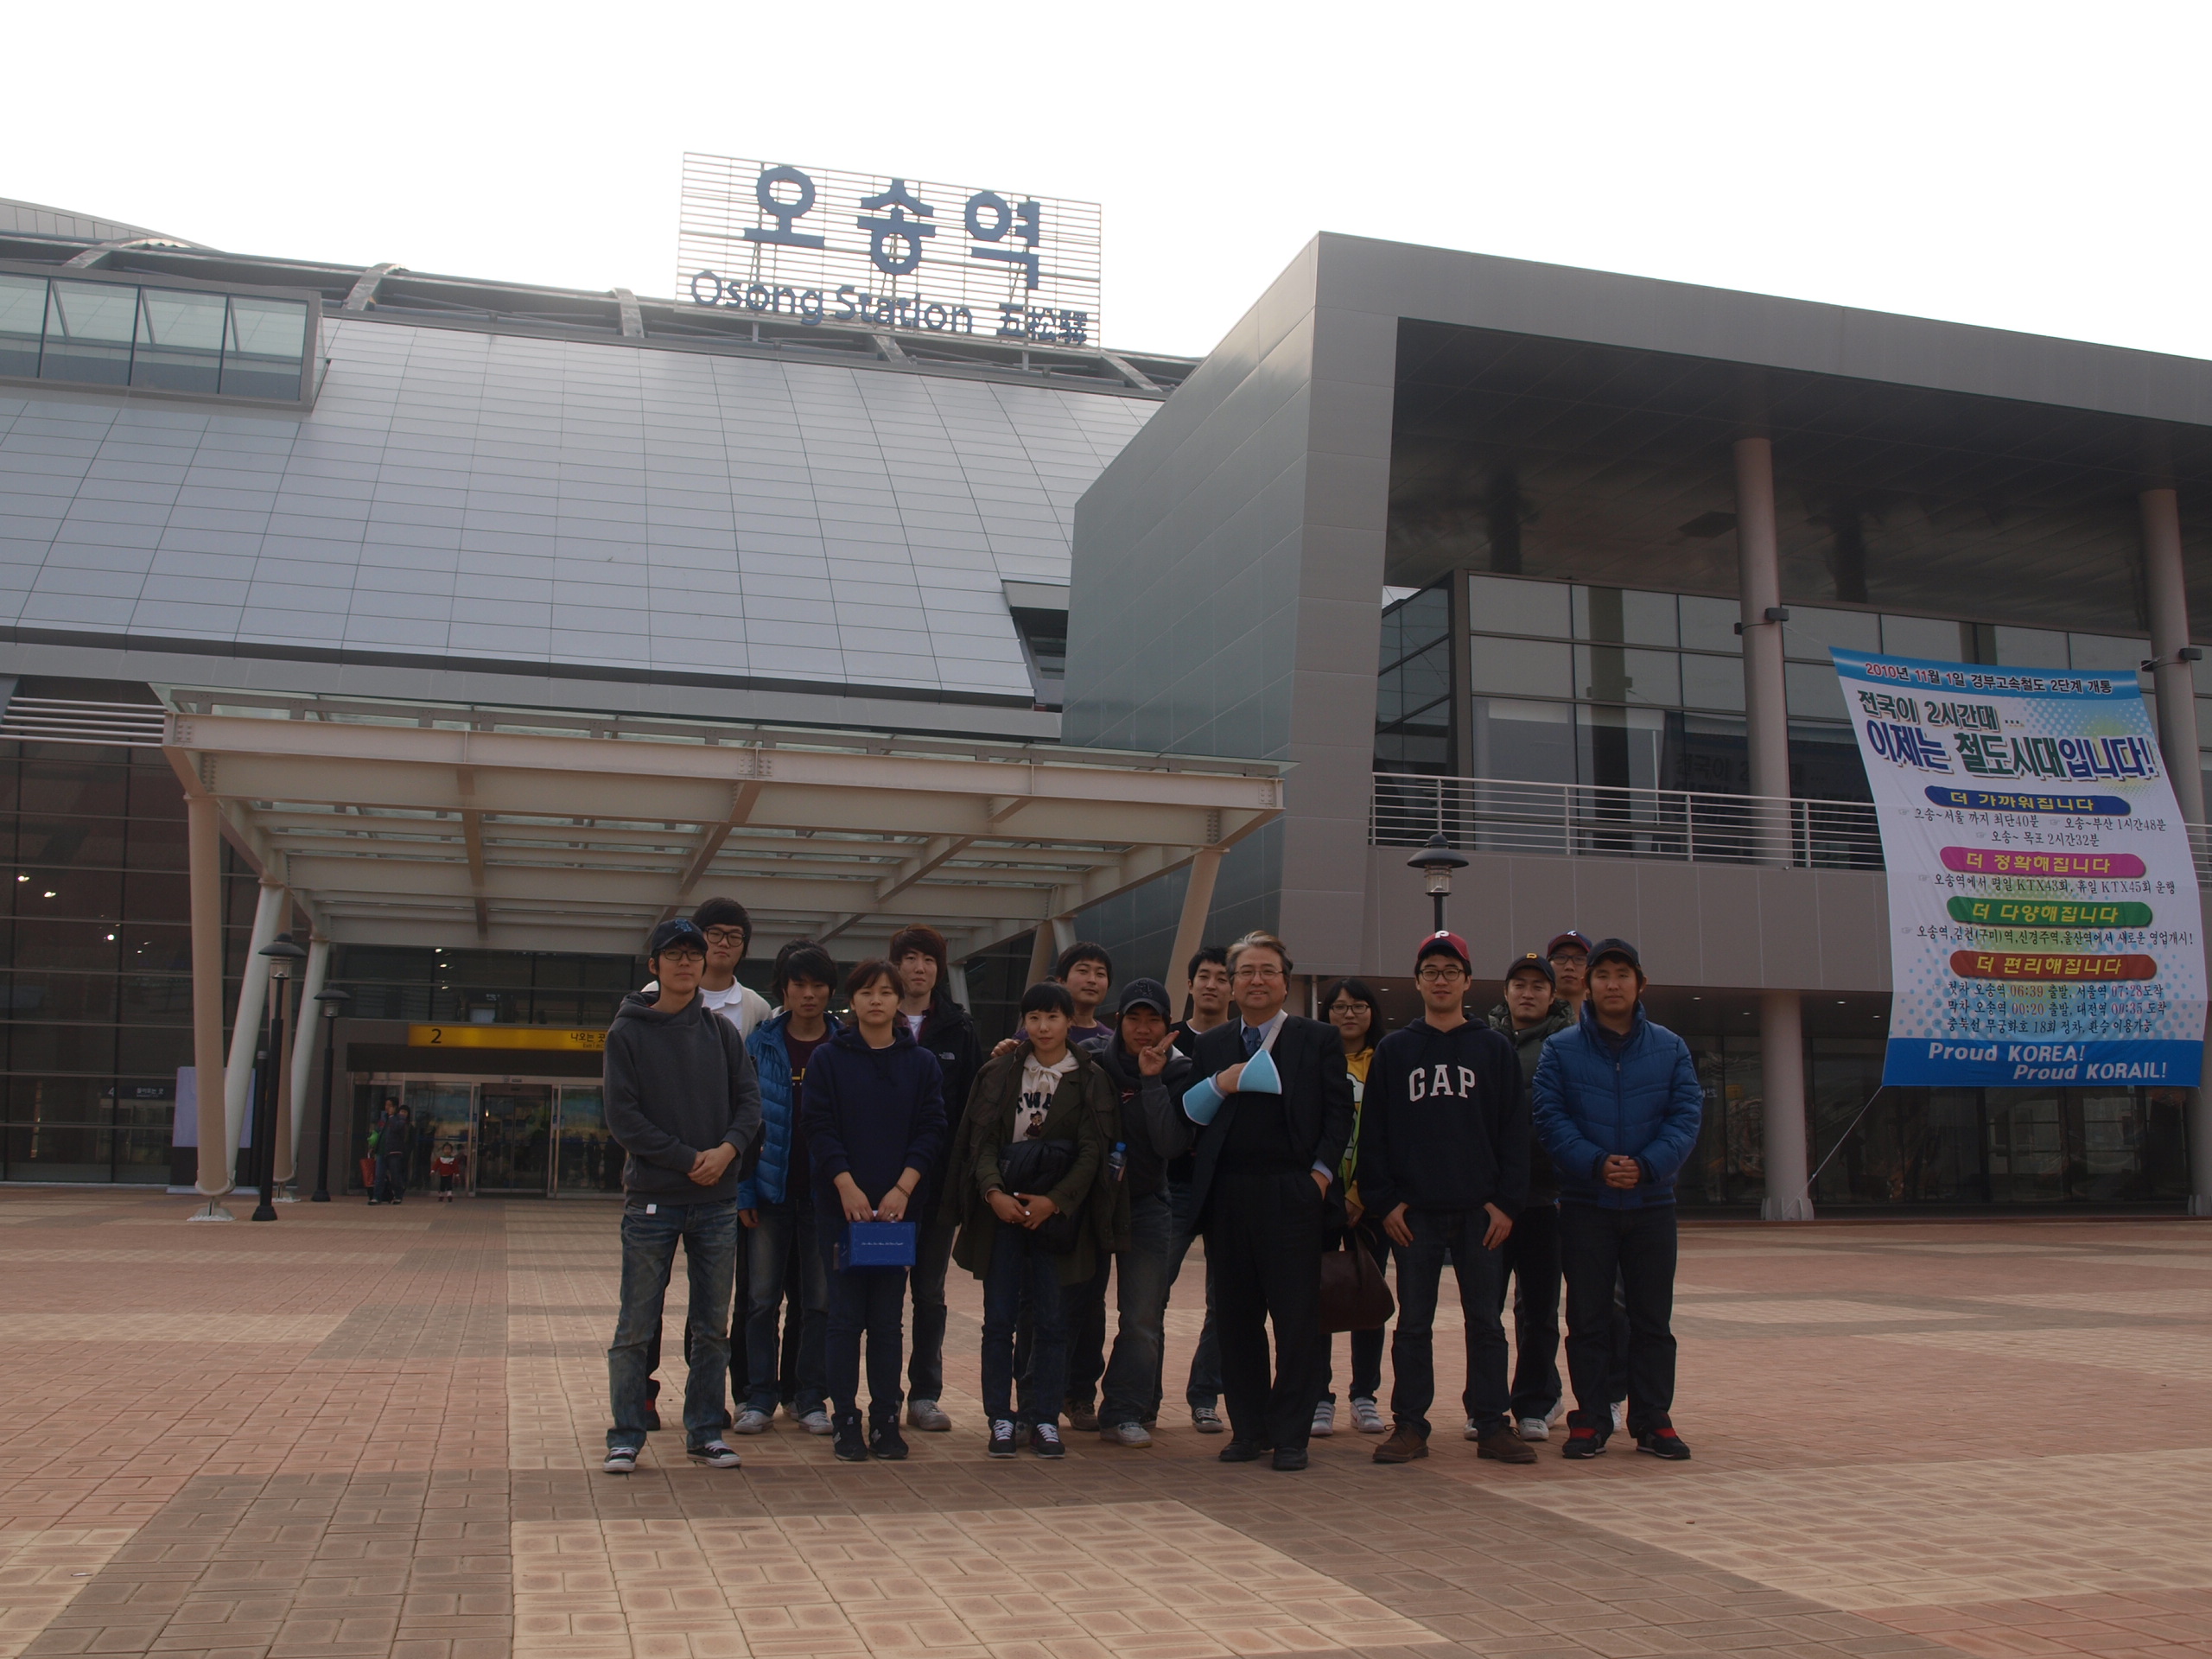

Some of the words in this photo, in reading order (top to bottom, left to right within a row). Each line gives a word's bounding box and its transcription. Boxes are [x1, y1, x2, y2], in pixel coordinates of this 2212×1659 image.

[743, 166, 1040, 290] 오송역
[691, 270, 823, 325] Osong
[835, 286, 972, 334] Station
[1866, 663, 1909, 681] 2010년
[1915, 670, 1941, 684] 11월
[1946, 672, 1966, 687] 1일
[1971, 674, 2045, 692] 경부고속철도
[2050, 679, 2082, 693] 2단계
[2088, 680, 2112, 693] 개통
[1857, 690, 1918, 724] 전국이
[1924, 701, 1999, 733] 2시간대
[1866, 719, 1950, 771] 이제는
[1956, 733, 2157, 779] 철도시대입니다!
[1950, 791, 1968, 805] 더
[1979, 793, 2094, 811] 가까워집니다
[1969, 811, 1989, 825] 까지
[1994, 813, 2039, 828] 최단40분
[2065, 817, 2113, 830] 오송~부산
[2118, 818, 2166, 831] 1시간48분
[2048, 832, 2100, 847] 2시간32분
[1967, 852, 1983, 868] 더
[1994, 854, 2110, 874] 정확해집니다
[1935, 874, 1986, 890] 오송역에서
[1992, 877, 2012, 892] 평일
[2077, 880, 2098, 894] 휴일
[2101, 880, 2152, 894] KTX45회
[2156, 880, 2175, 894] 운행
[1973, 903, 1989, 920] 더
[2000, 904, 2119, 924] 다양해집니다
[2117, 931, 2145, 946] 새로운
[1977, 957, 1994, 972] 더
[2004, 957, 2122, 976] 편리해집니다
[1974, 982, 2005, 998] 오송역
[2010, 985, 2044, 997] 06:39
[2077, 985, 2107, 999] 서울역
[1948, 999, 1970, 1014] 막차
[1974, 1001, 2006, 1015] 오송역
[2012, 1002, 2044, 1015] 00:20
[2077, 1002, 2107, 1017] 대전역
[2146, 1002, 2167, 1015] 도착
[430, 1028, 442, 1044] 2
[1986, 1019, 2028, 1033] 무궁화호
[2033, 1020, 2056, 1033] 18회
[1928, 1041, 1997, 1062] Proud
[2007, 1045, 2086, 1063] KOREA!
[2012, 1063, 2076, 1080] Proud
[2085, 1061, 2167, 1080] KORAIL!
[1408, 1064, 1476, 1103] GAP
